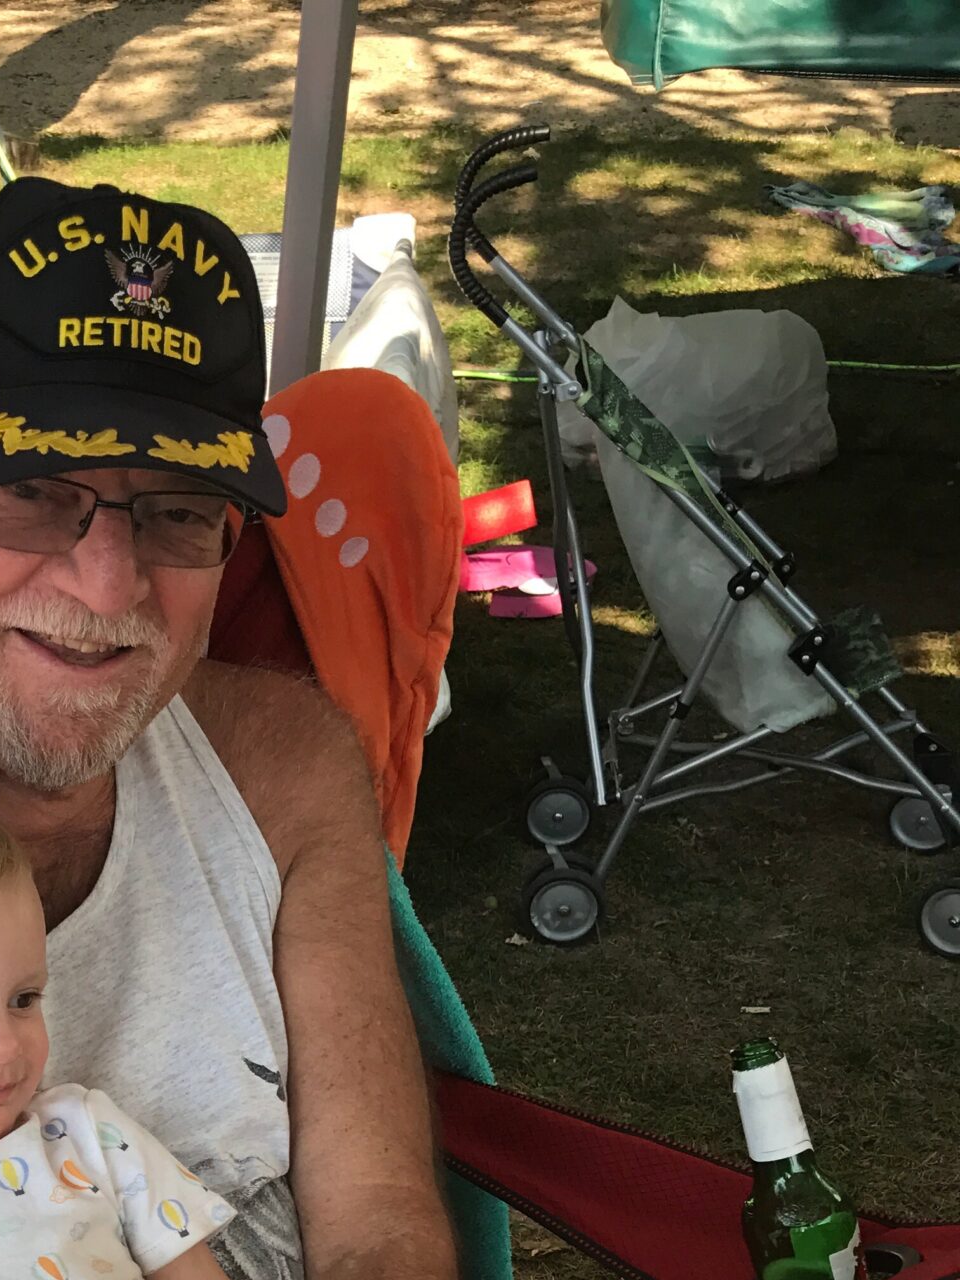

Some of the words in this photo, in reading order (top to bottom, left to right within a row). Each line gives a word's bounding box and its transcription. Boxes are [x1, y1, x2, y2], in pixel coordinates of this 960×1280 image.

[8, 214, 105, 278] U.S.
[121, 206, 240, 305] NAVY
[58, 316, 202, 366] RETIRED
